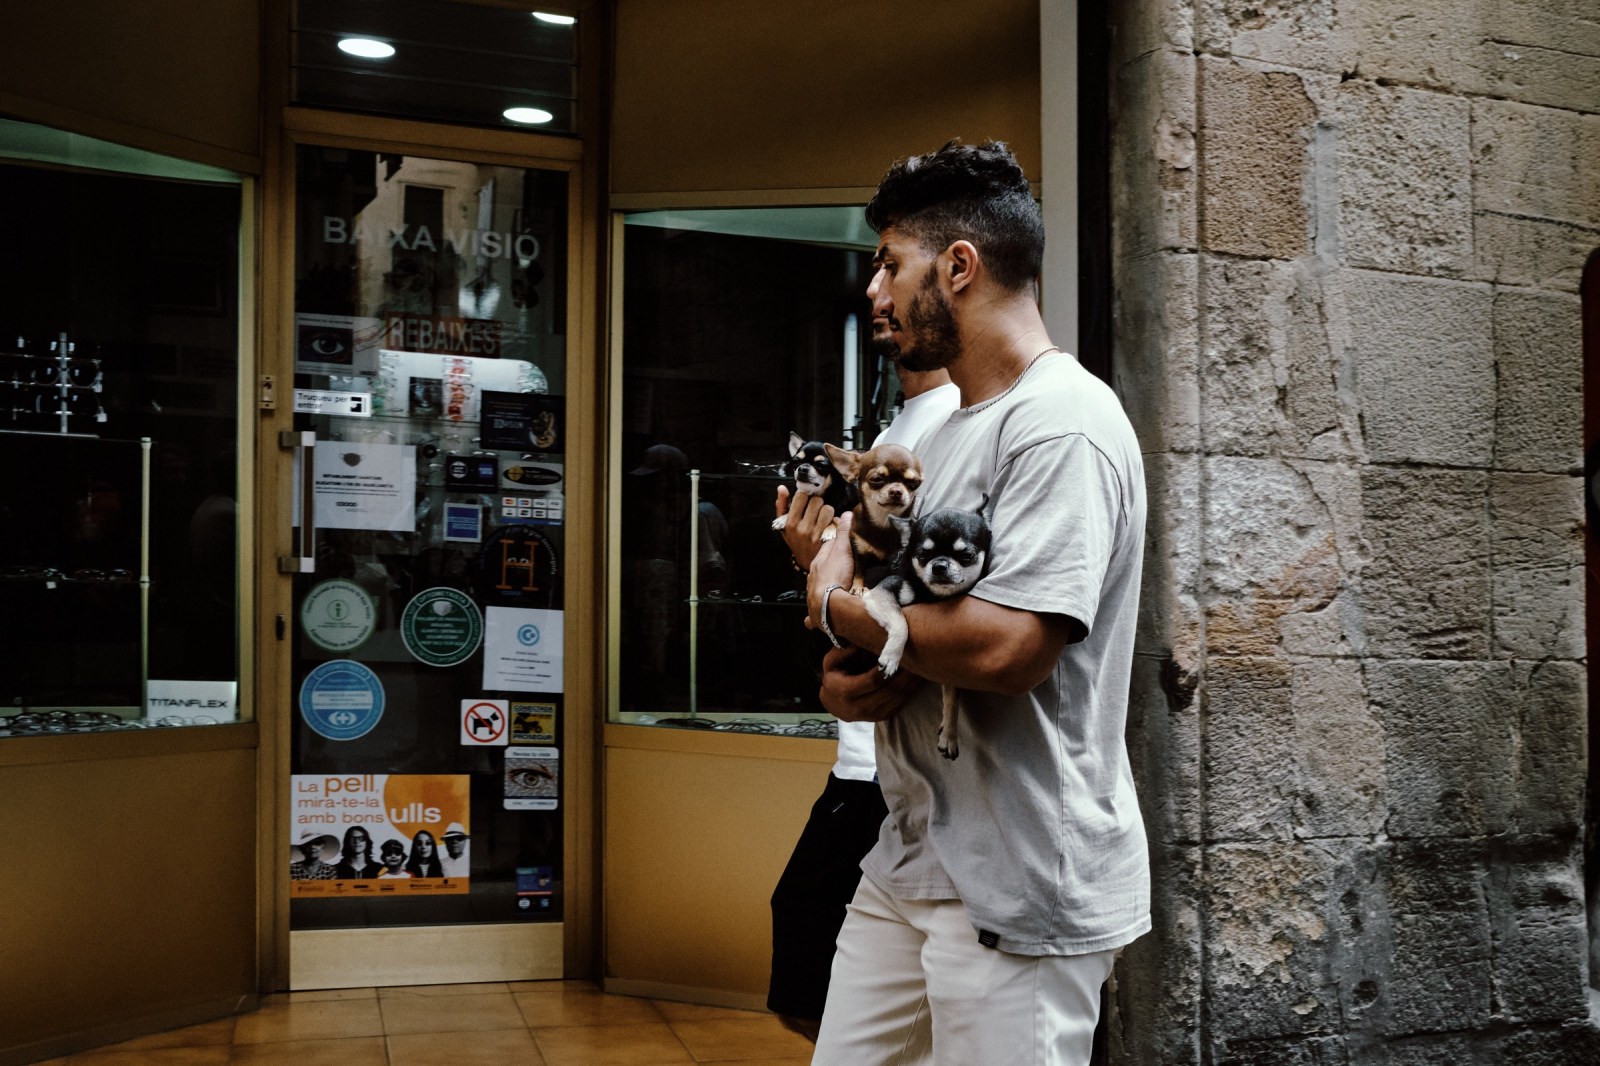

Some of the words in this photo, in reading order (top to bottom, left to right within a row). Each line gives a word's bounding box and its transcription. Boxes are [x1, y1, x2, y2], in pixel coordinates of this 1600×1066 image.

[446, 227, 540, 262] VISIÓ
[389, 317, 498, 354] REBAIXES
[149, 698, 228, 708] TITANFLEX
[512, 734, 554, 742] PROSEGUR
[298, 781, 319, 793] La
[298, 796, 380, 808] mira-te-la
[298, 812, 337, 824] amb
[342, 811, 385, 824] bons
[390, 802, 442, 823] ulls
